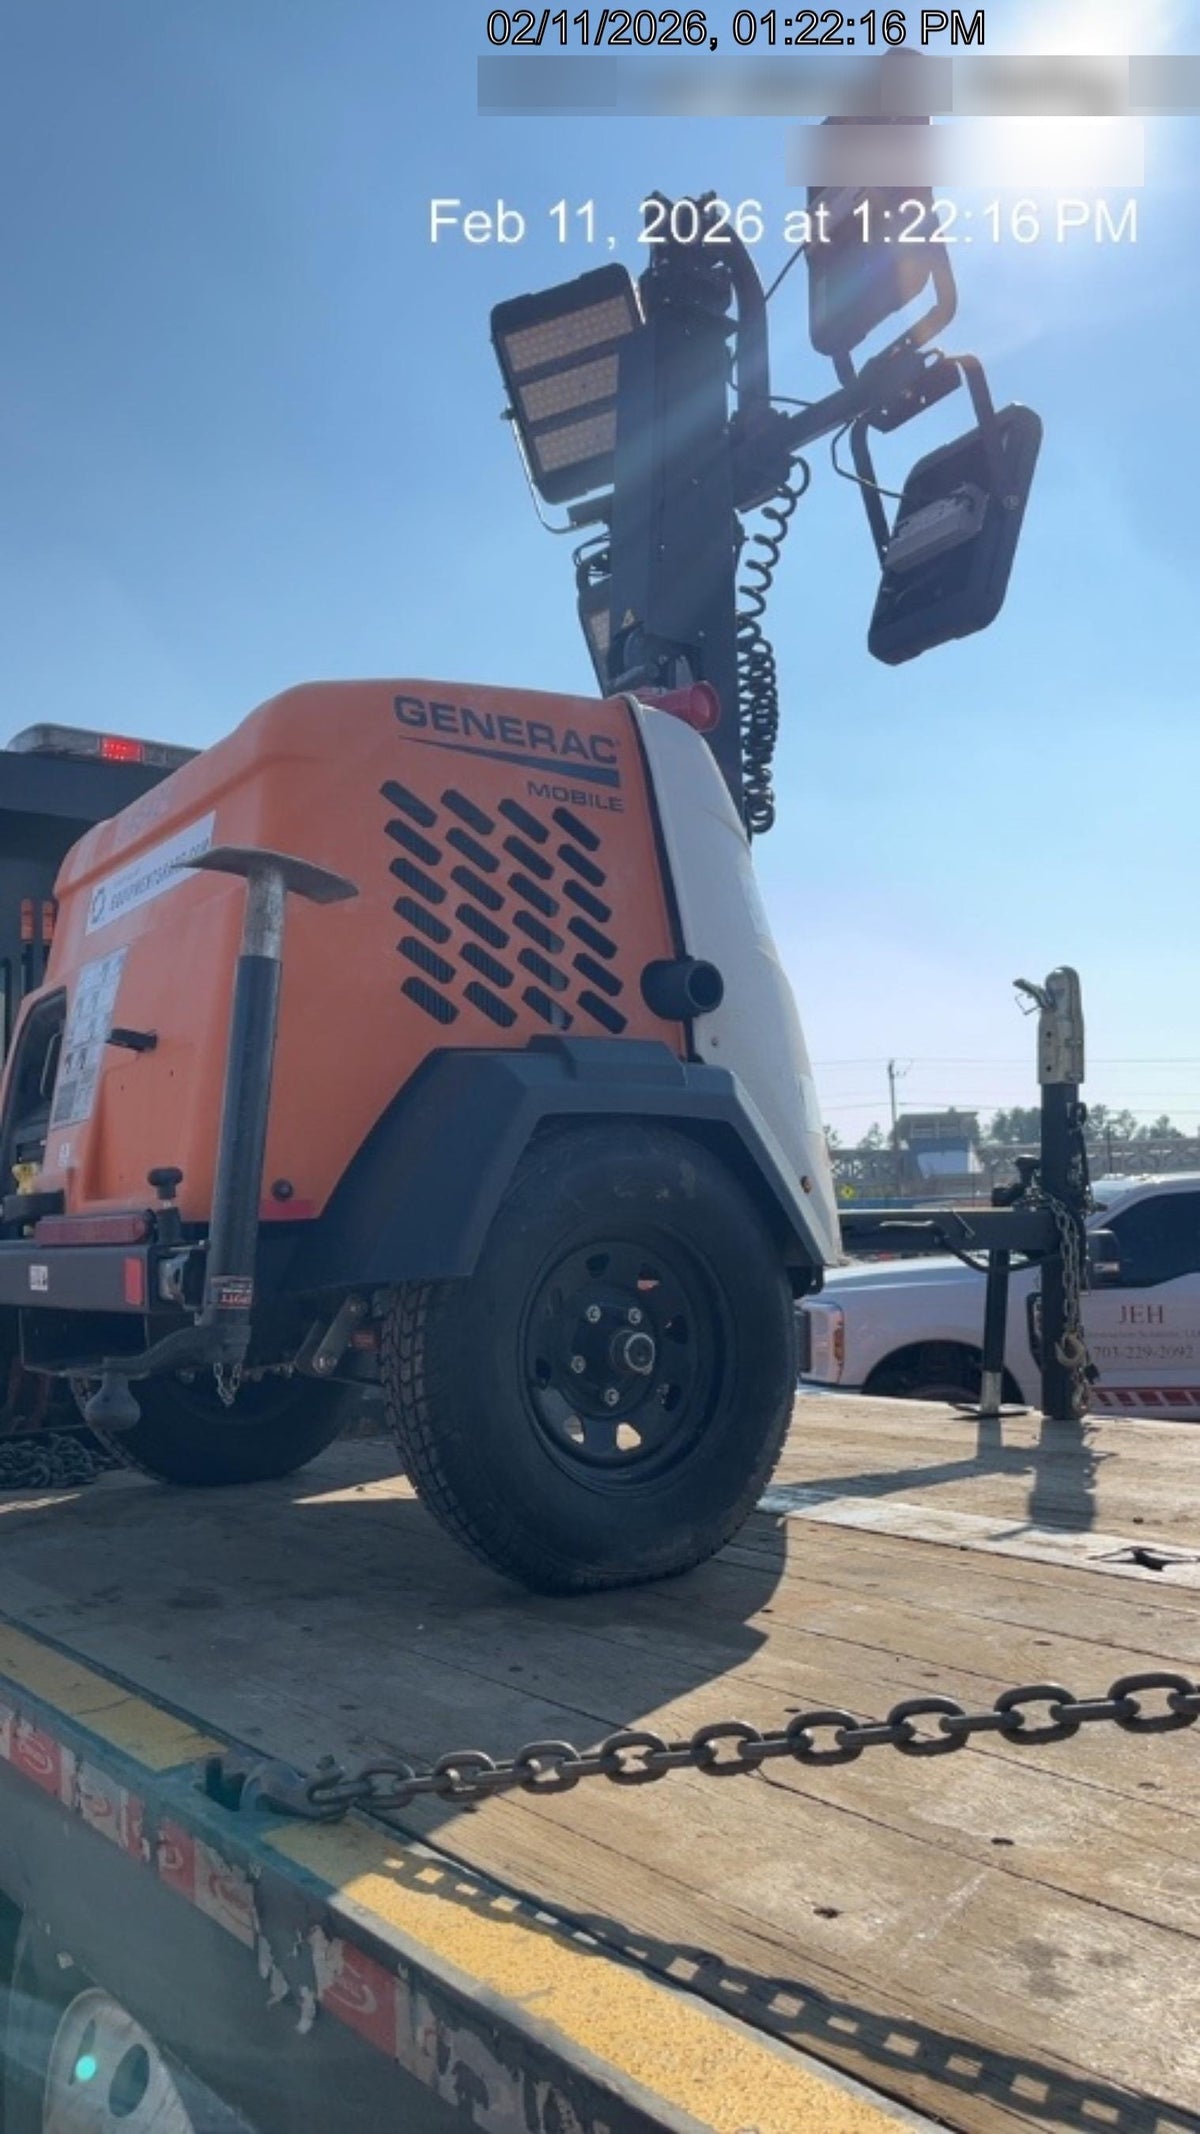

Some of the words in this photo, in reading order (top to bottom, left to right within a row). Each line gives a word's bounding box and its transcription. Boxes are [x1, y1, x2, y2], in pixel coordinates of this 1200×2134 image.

[393, 695, 618, 764] GENERAC
[526, 780, 624, 813] MOBILE
[1119, 1304, 1163, 1324] JEH
